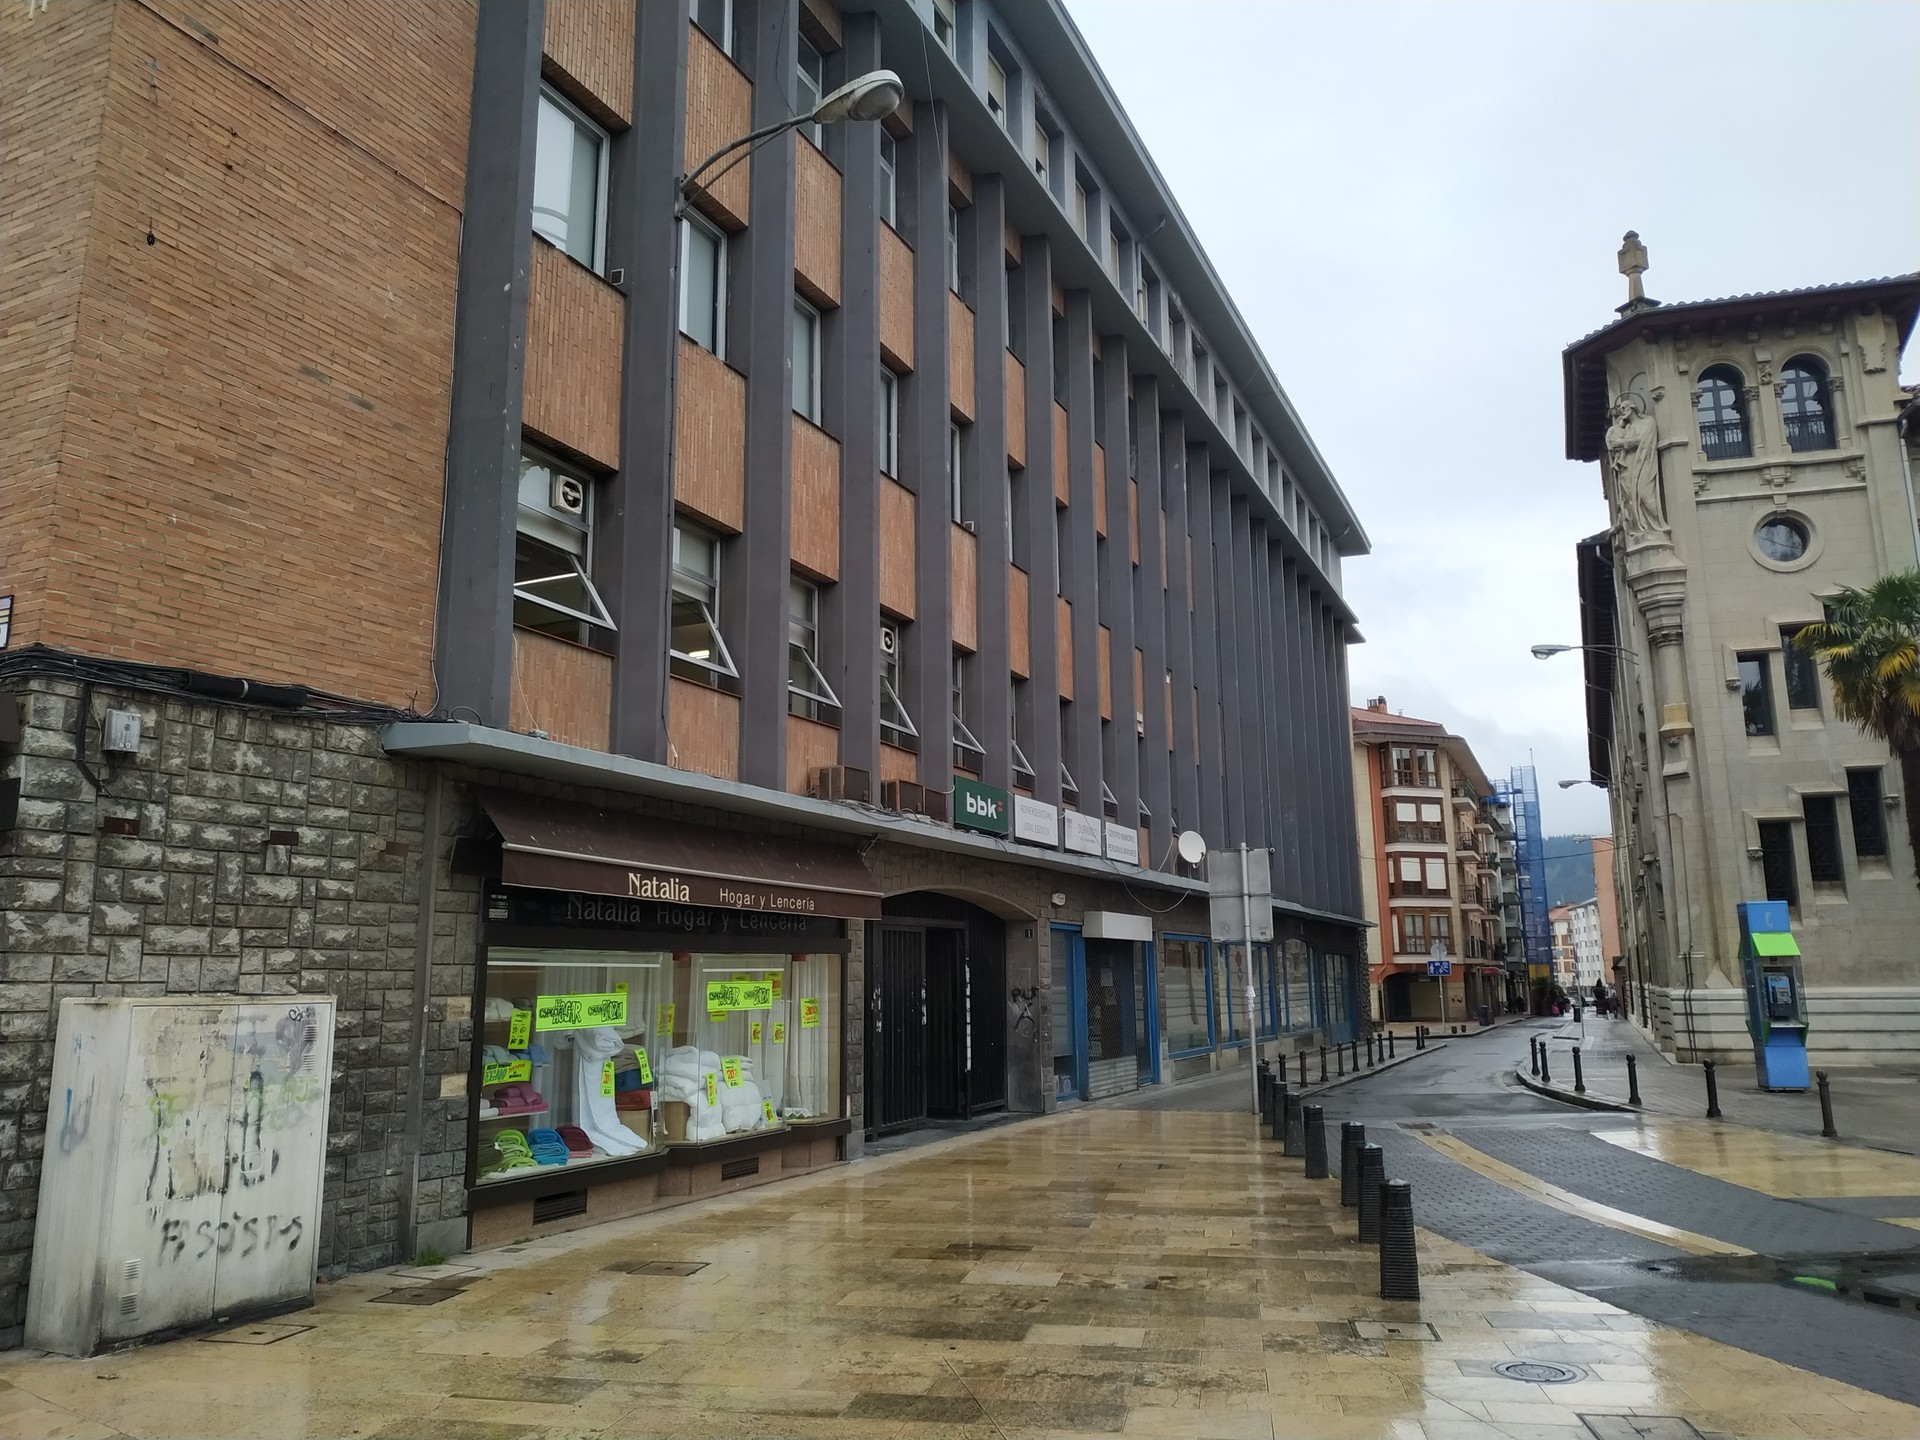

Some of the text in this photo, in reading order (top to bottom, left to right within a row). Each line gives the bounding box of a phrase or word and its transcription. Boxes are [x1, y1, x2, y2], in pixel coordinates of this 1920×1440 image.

[628, 872, 690, 903] Natalia
[719, 887, 816, 911] Hogar y Lencería
[567, 894, 641, 923] Natalia
[656, 903, 714, 931] Hogar
